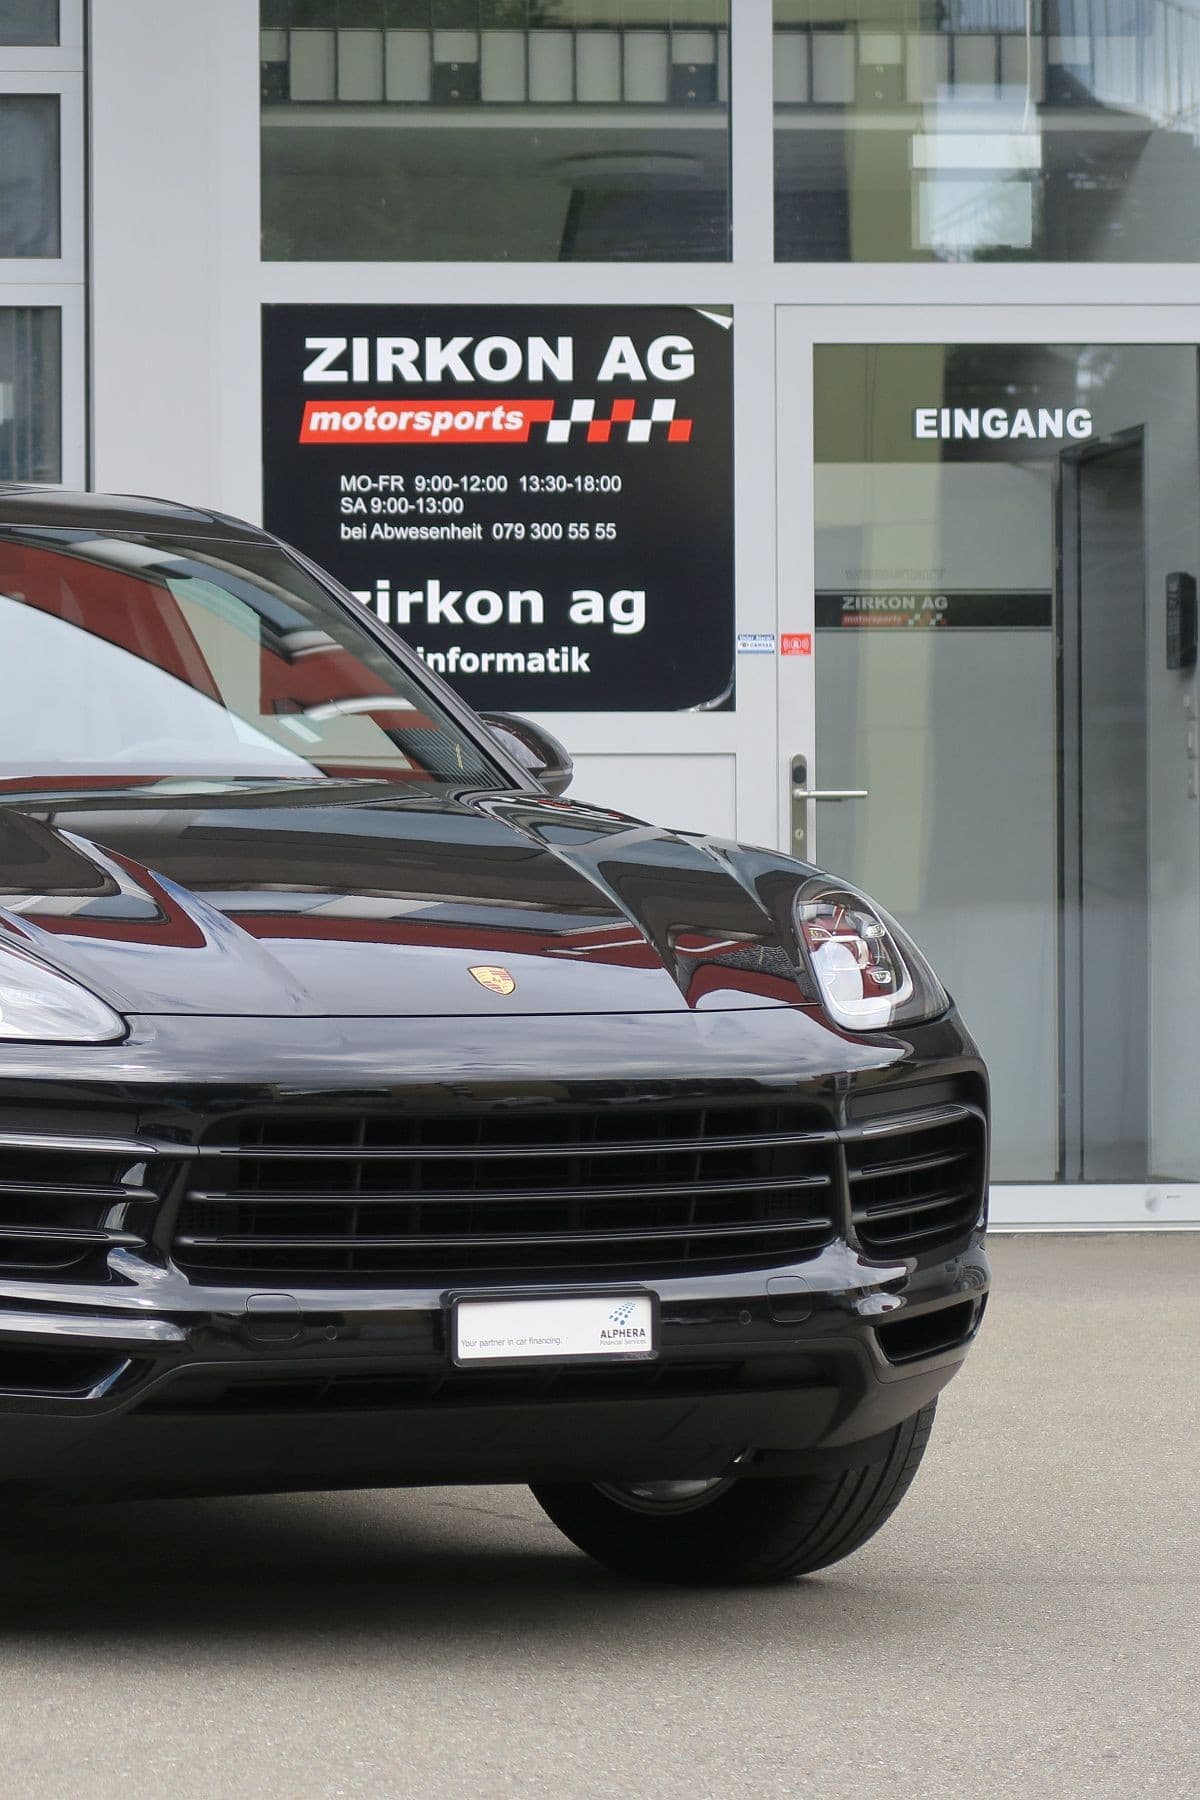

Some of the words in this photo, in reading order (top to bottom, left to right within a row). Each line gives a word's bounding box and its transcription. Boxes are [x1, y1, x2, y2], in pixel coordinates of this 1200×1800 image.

[303, 336, 573, 382] ZIRKON
[597, 336, 694, 381] AG
[310, 406, 523, 436] motorsports
[916, 408, 1092, 438] EINGANG
[341, 475, 404, 492] MO-FR
[415, 475, 508, 492] 9:00-12:00
[520, 475, 621, 492] 13:30-18:00
[341, 497, 367, 514] SA
[371, 497, 464, 514] 9:00-13:00
[341, 523, 367, 540] bei
[370, 523, 482, 540] Abwesenheit
[493, 523, 525, 540] 079
[531, 523, 562, 540] 300
[568, 523, 589, 540] 55
[595, 523, 616, 540] 55
[842, 596, 915, 610] ZIRKON
[922, 596, 948, 610] AG
[570, 590, 645, 634] ag
[600, 1328, 646, 1338] ALPHERA
[461, 1340, 478, 1348] Your
[479, 1339, 505, 1349] partner
[515, 1337, 527, 1346] car
